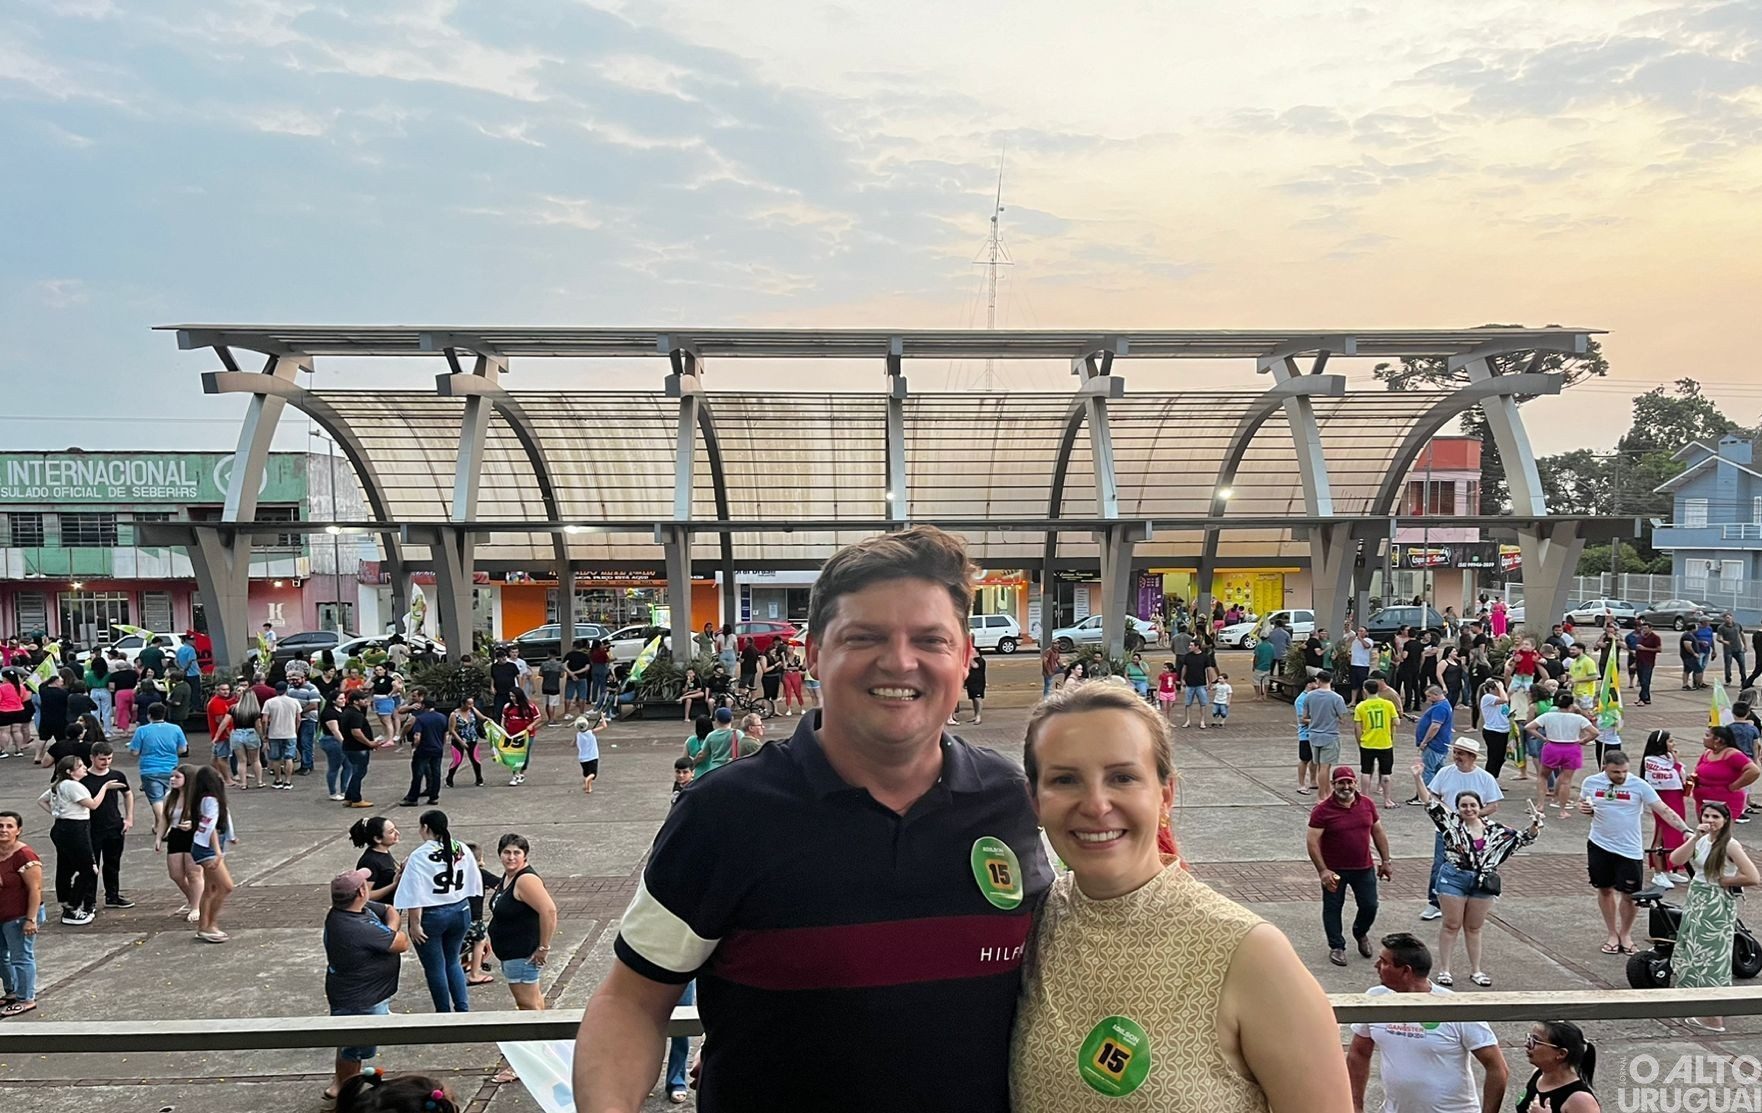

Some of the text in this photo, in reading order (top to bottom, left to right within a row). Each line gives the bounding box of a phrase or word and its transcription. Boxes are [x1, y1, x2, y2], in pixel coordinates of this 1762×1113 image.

[7, 460, 197, 486] INTERNACIONAL
[53, 487, 101, 498] OFICIAL
[108, 487, 126, 498] DE
[1367, 710, 1384, 729] 10
[988, 863, 1011, 885] 15
[980, 941, 1026, 962] HILF
[1097, 1042, 1130, 1073] 15
